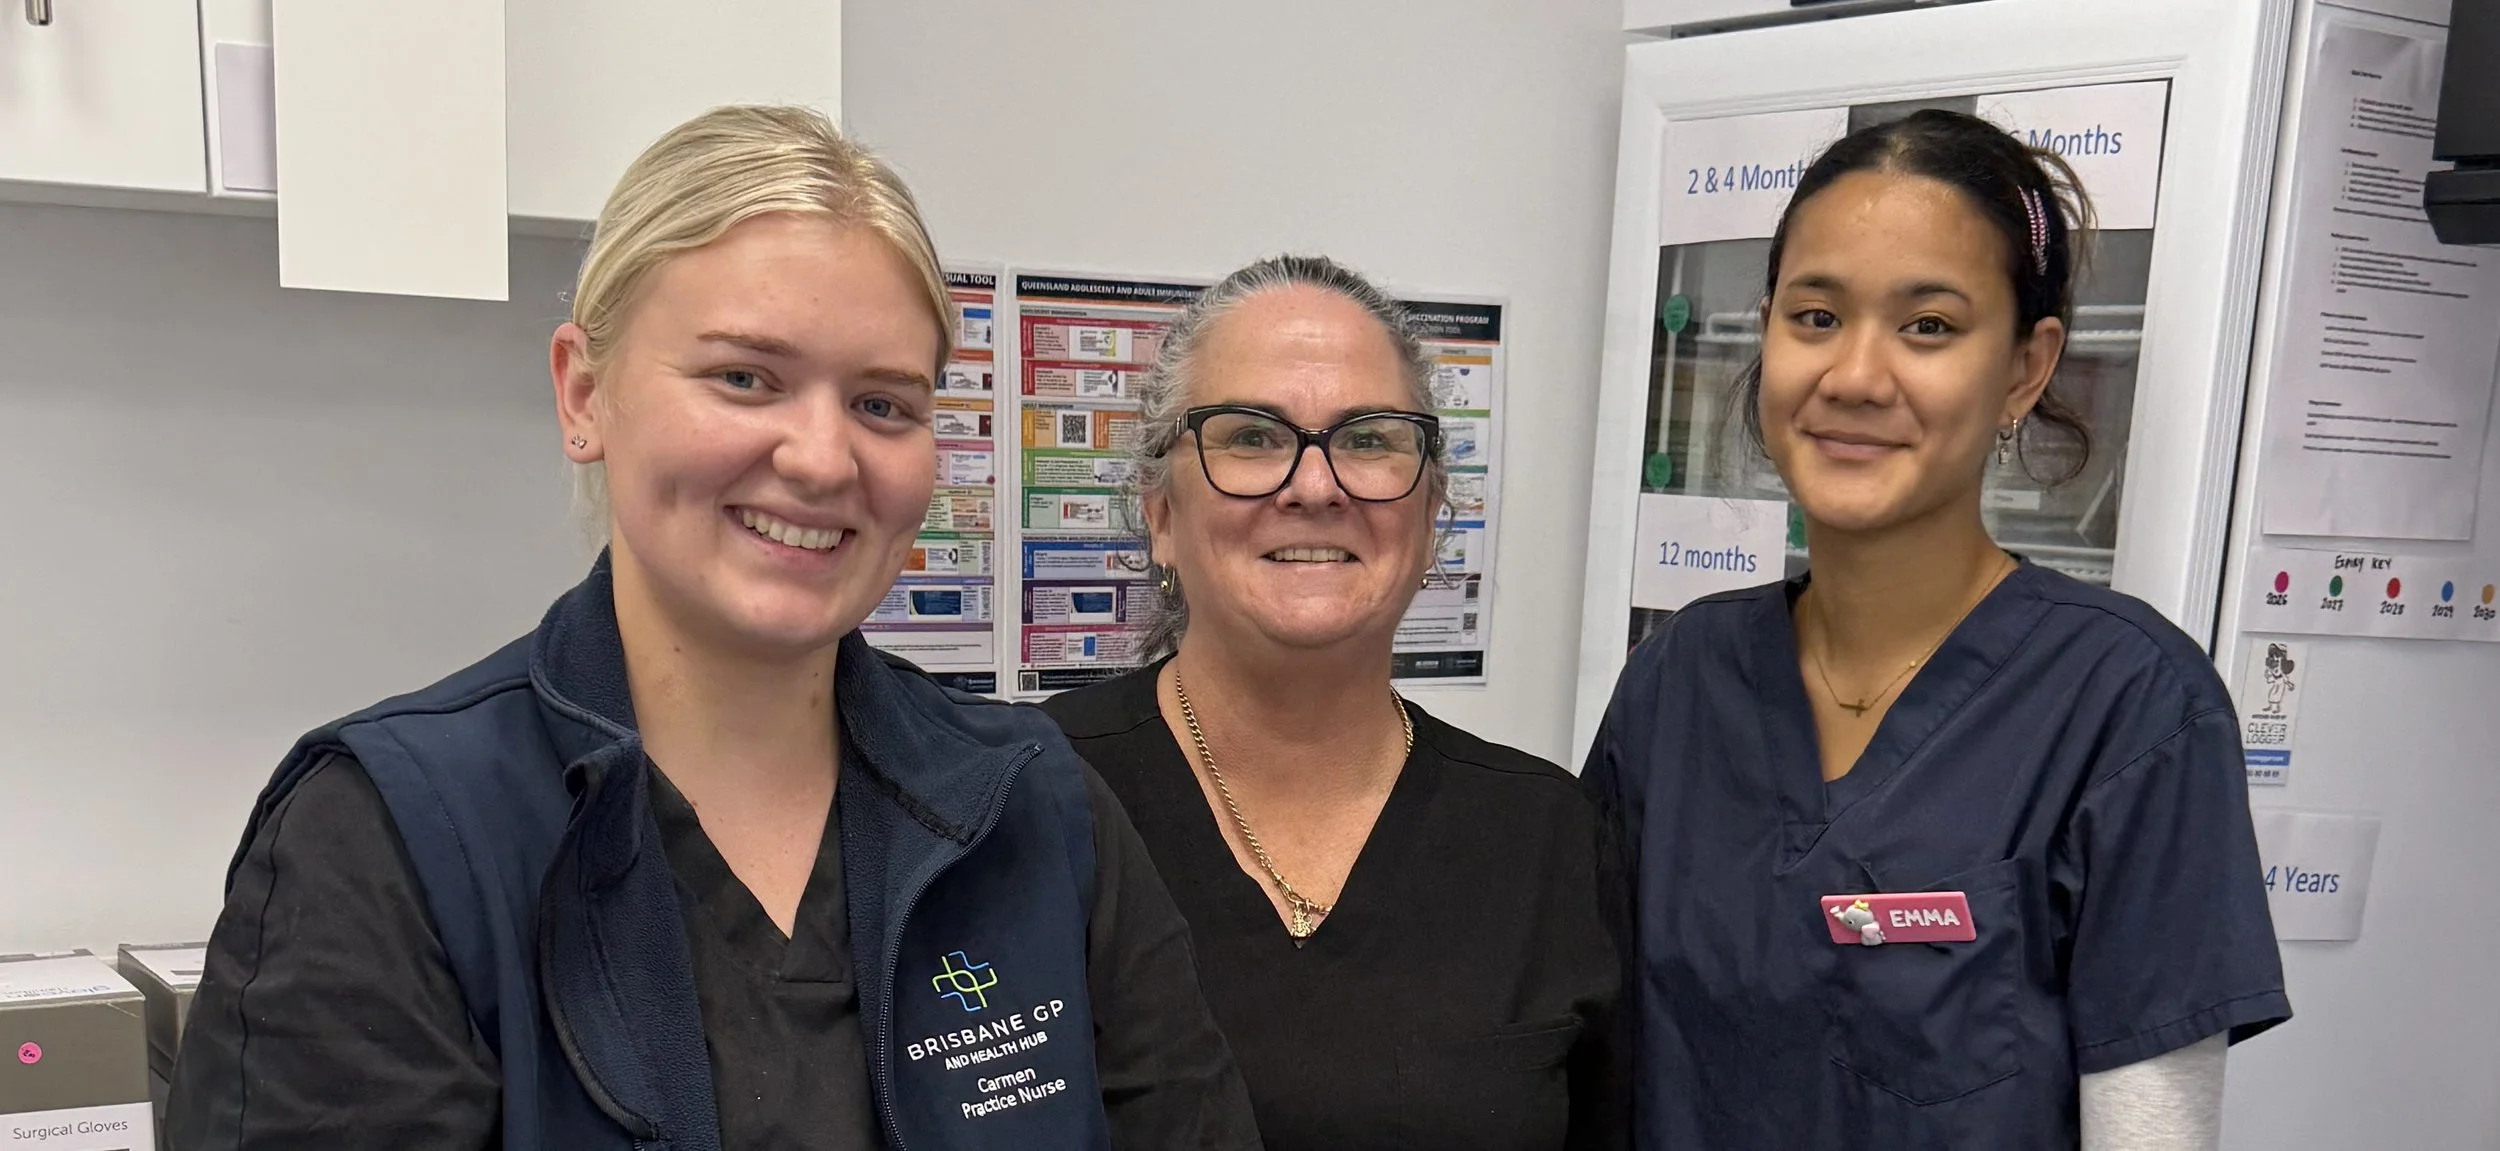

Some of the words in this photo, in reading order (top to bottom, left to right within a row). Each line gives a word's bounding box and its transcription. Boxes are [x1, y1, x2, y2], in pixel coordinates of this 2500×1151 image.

[2029, 123, 2123, 156] Months
[1687, 168, 1699, 195] 2
[1704, 166, 1719, 194] &
[1723, 165, 1735, 192] 4
[1740, 159, 1807, 191] Month
[943, 273, 968, 284] SUAL
[970, 274, 995, 285] TOOL
[1021, 280, 1070, 291] QUEENSLAND
[1070, 283, 1115, 294] ADOLESCENT
[1116, 286, 1132, 296] AND
[1659, 540, 1680, 566] 12
[1684, 544, 1757, 573] months
[2371, 556, 2392, 570] KEY
[2320, 597, 2344, 612] 2027
[2379, 600, 2405, 615] 2028
[2432, 604, 2454, 619] 2029
[2473, 605, 2496, 620] 2030
[2247, 722, 2288, 734] CLEVER
[2245, 733, 2286, 745] LOGGER
[2264, 865, 2277, 892] 4
[2285, 866, 2340, 893] Years
[1888, 908, 1961, 928] EMMA
[907, 1013, 1026, 1061] BRISBANE
[1033, 999, 1065, 1022] GP
[945, 1056, 970, 1071] AND
[970, 1041, 1019, 1065] HEALTH
[1019, 1031, 1048, 1051] HUB
[977, 1067, 1037, 1093] Carmen
[961, 1094, 1018, 1119] Practice
[1017, 1077, 1067, 1103] Nurse
[13, 1123, 73, 1141] Surgical
[77, 1120, 128, 1135] Gloves
